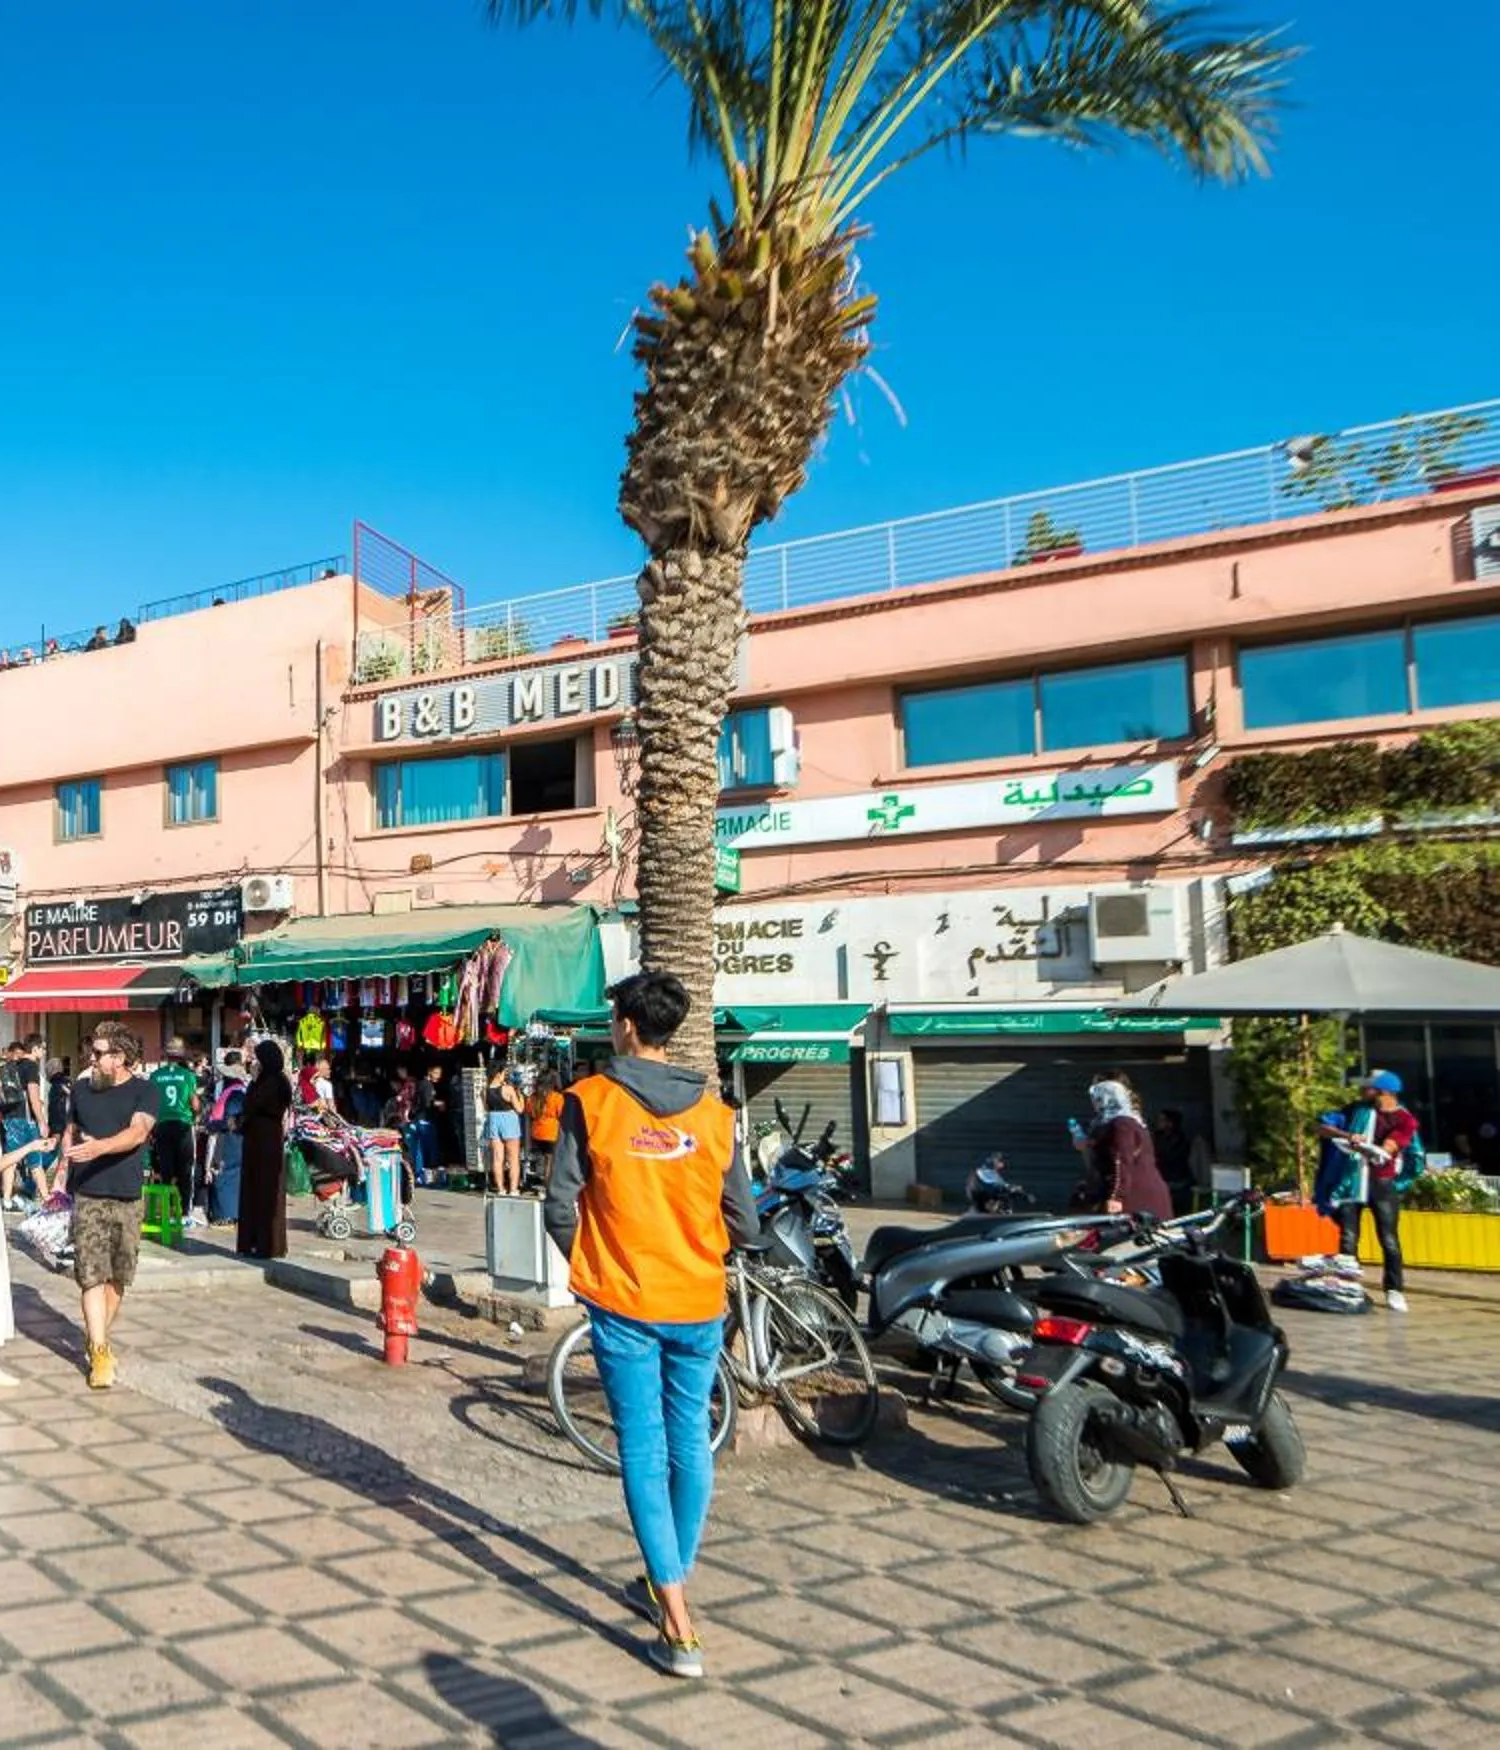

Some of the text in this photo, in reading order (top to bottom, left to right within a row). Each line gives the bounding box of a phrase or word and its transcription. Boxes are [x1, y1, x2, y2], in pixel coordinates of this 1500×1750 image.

[380, 661, 621, 740] B&B MED
[1002, 778, 1154, 811] صيدلية
[28, 908, 43, 926] LE
[187, 908, 237, 928] 59 DH
[28, 920, 183, 957] PARFUMEUR
[717, 941, 745, 955] DU
[165, 1085, 178, 1107] 9
